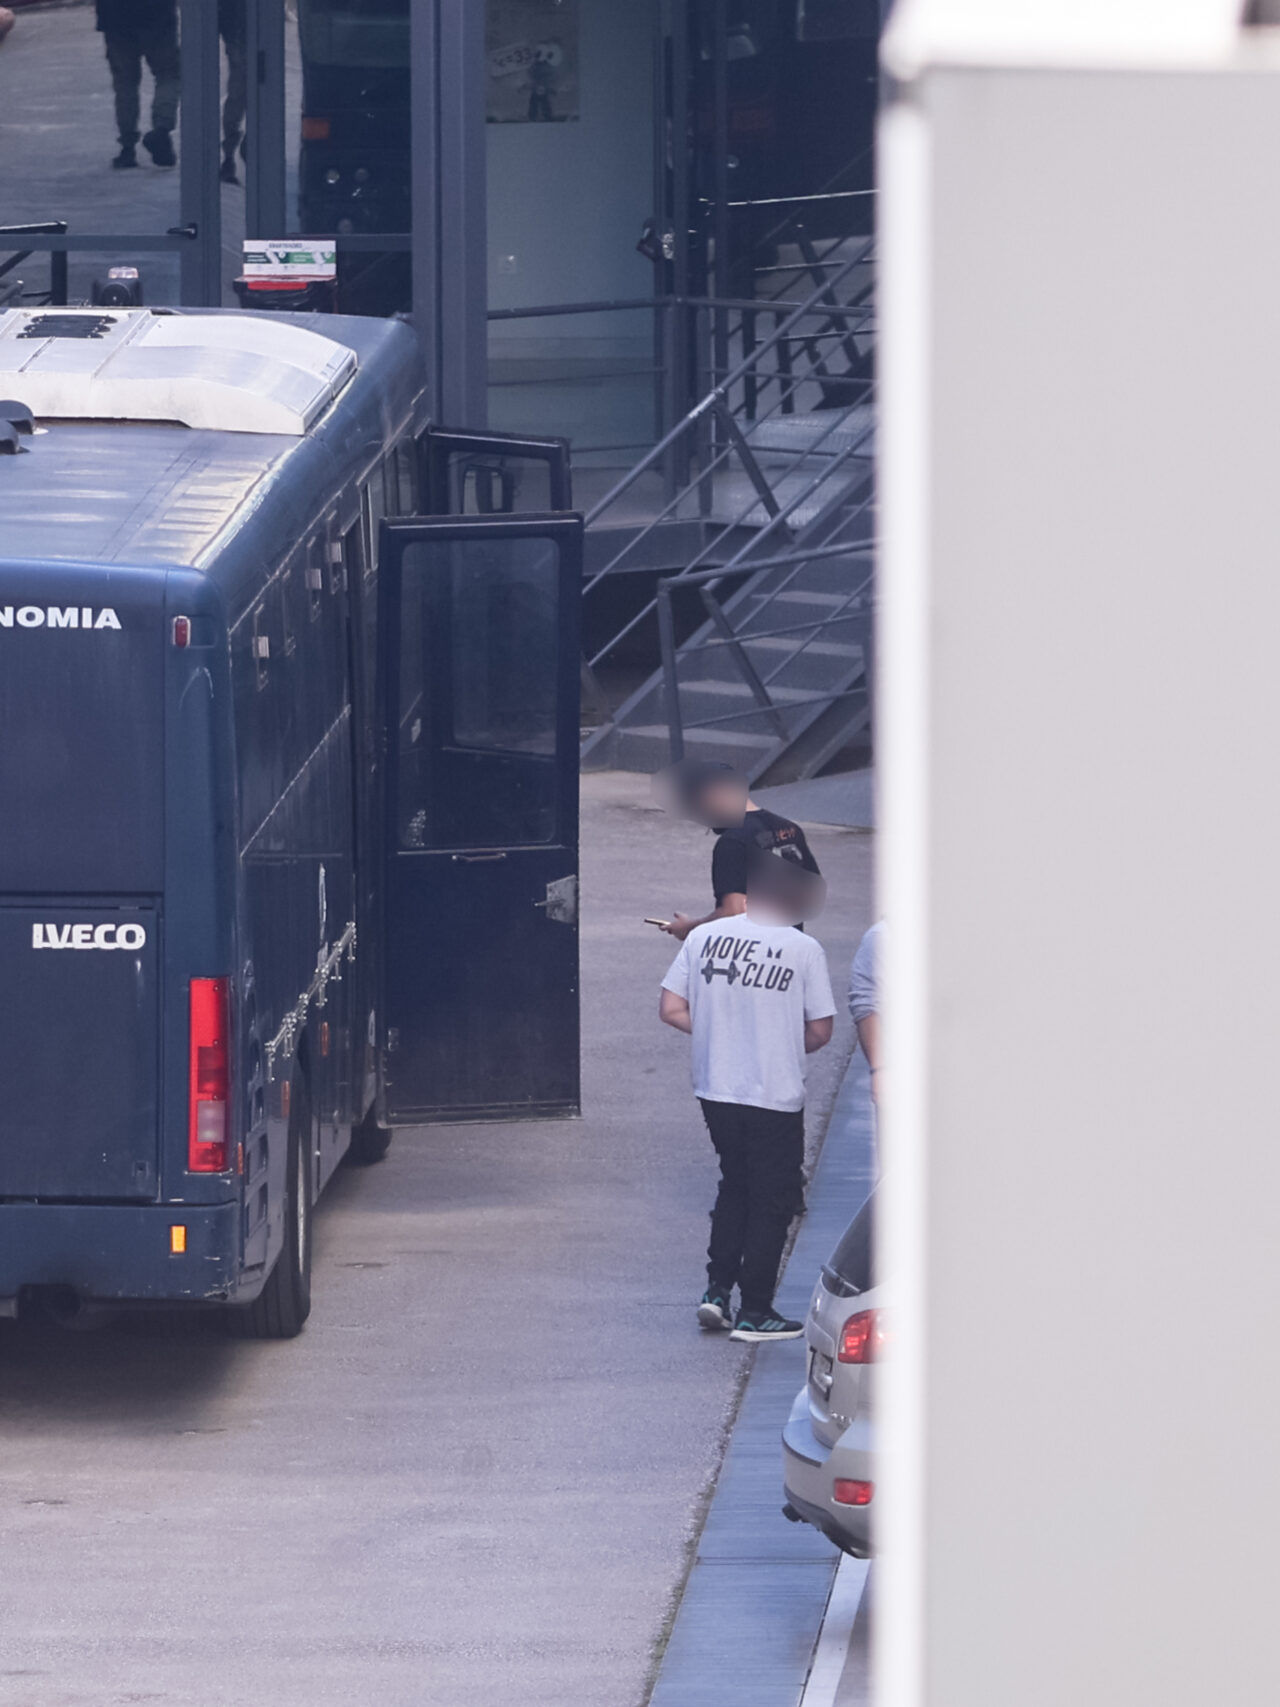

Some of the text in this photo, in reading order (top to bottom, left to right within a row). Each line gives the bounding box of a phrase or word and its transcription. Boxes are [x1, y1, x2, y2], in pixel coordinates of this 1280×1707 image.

[32, 923, 146, 950] IVECO
[700, 935, 761, 962] MOVE
[741, 962, 794, 992] CLUB
